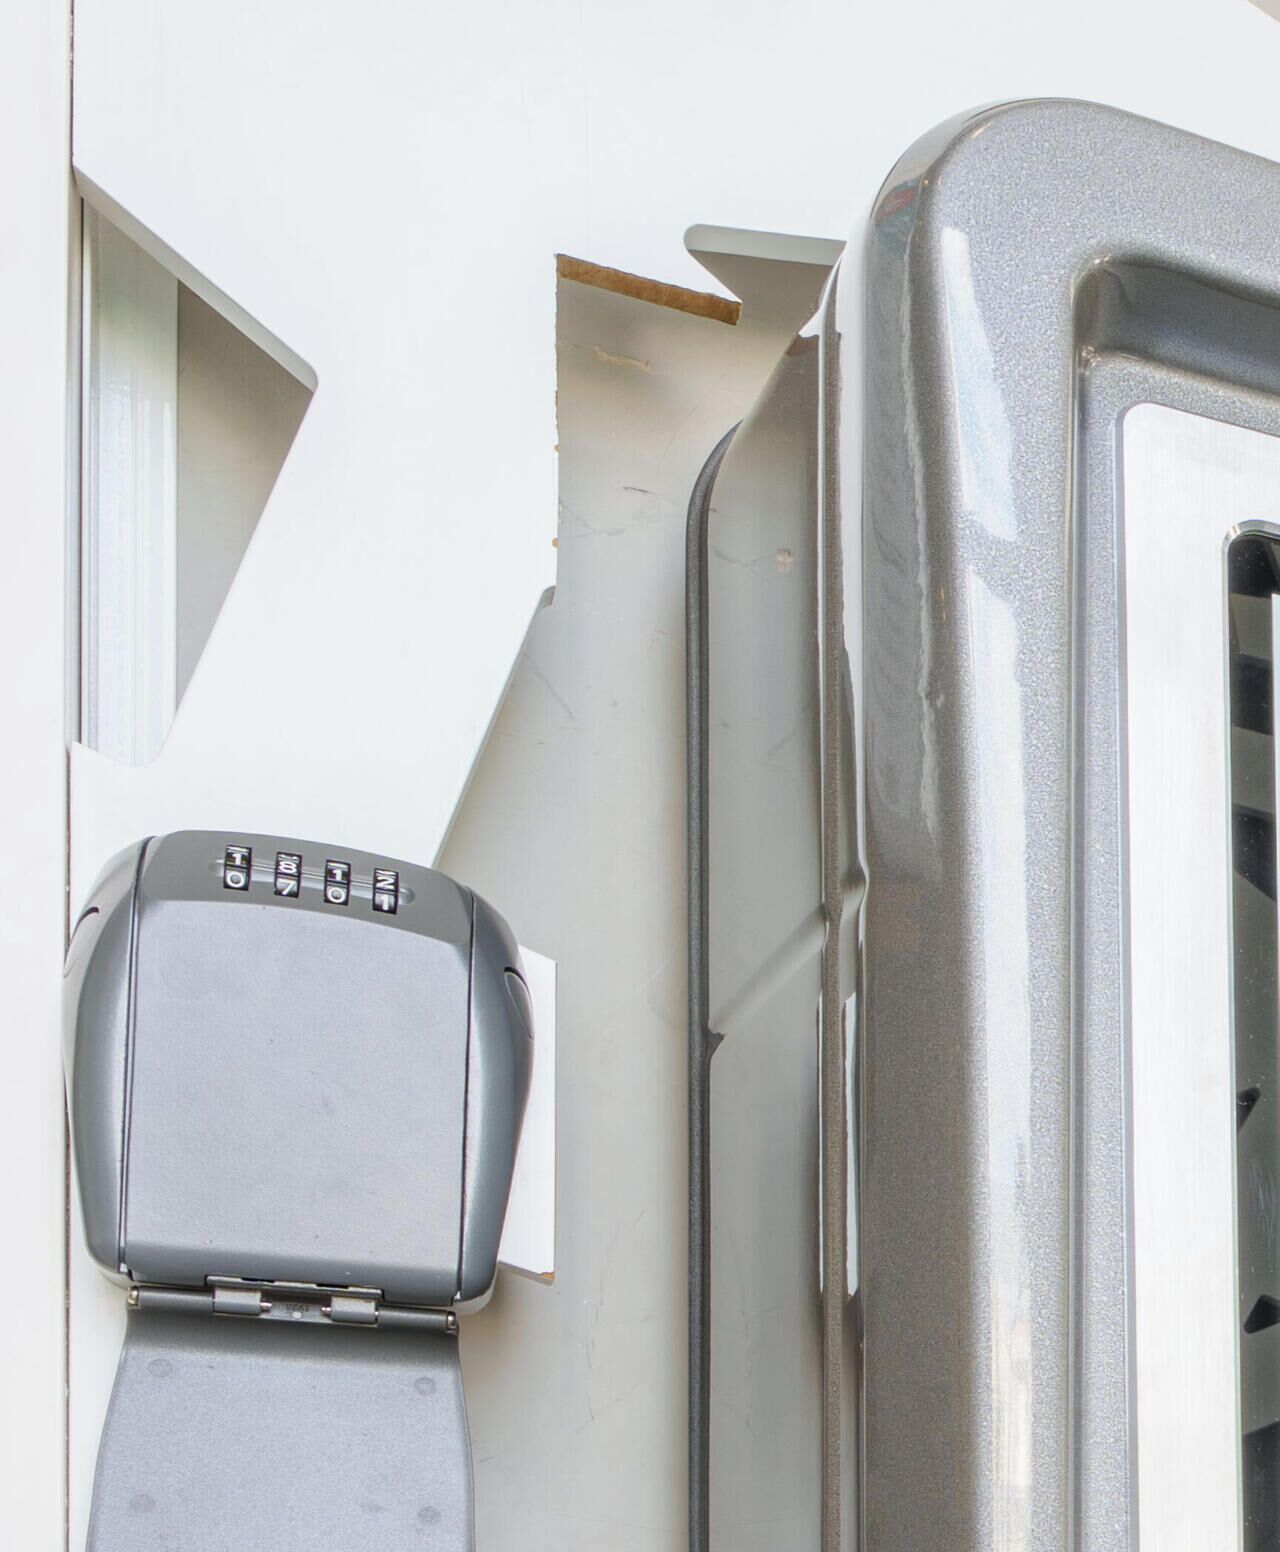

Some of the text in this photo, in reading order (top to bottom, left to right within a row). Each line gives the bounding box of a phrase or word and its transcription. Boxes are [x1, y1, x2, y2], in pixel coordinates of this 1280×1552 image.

[231, 853, 395, 890] 1 8 1 2
[226, 871, 389, 911] 0 7 0 1
